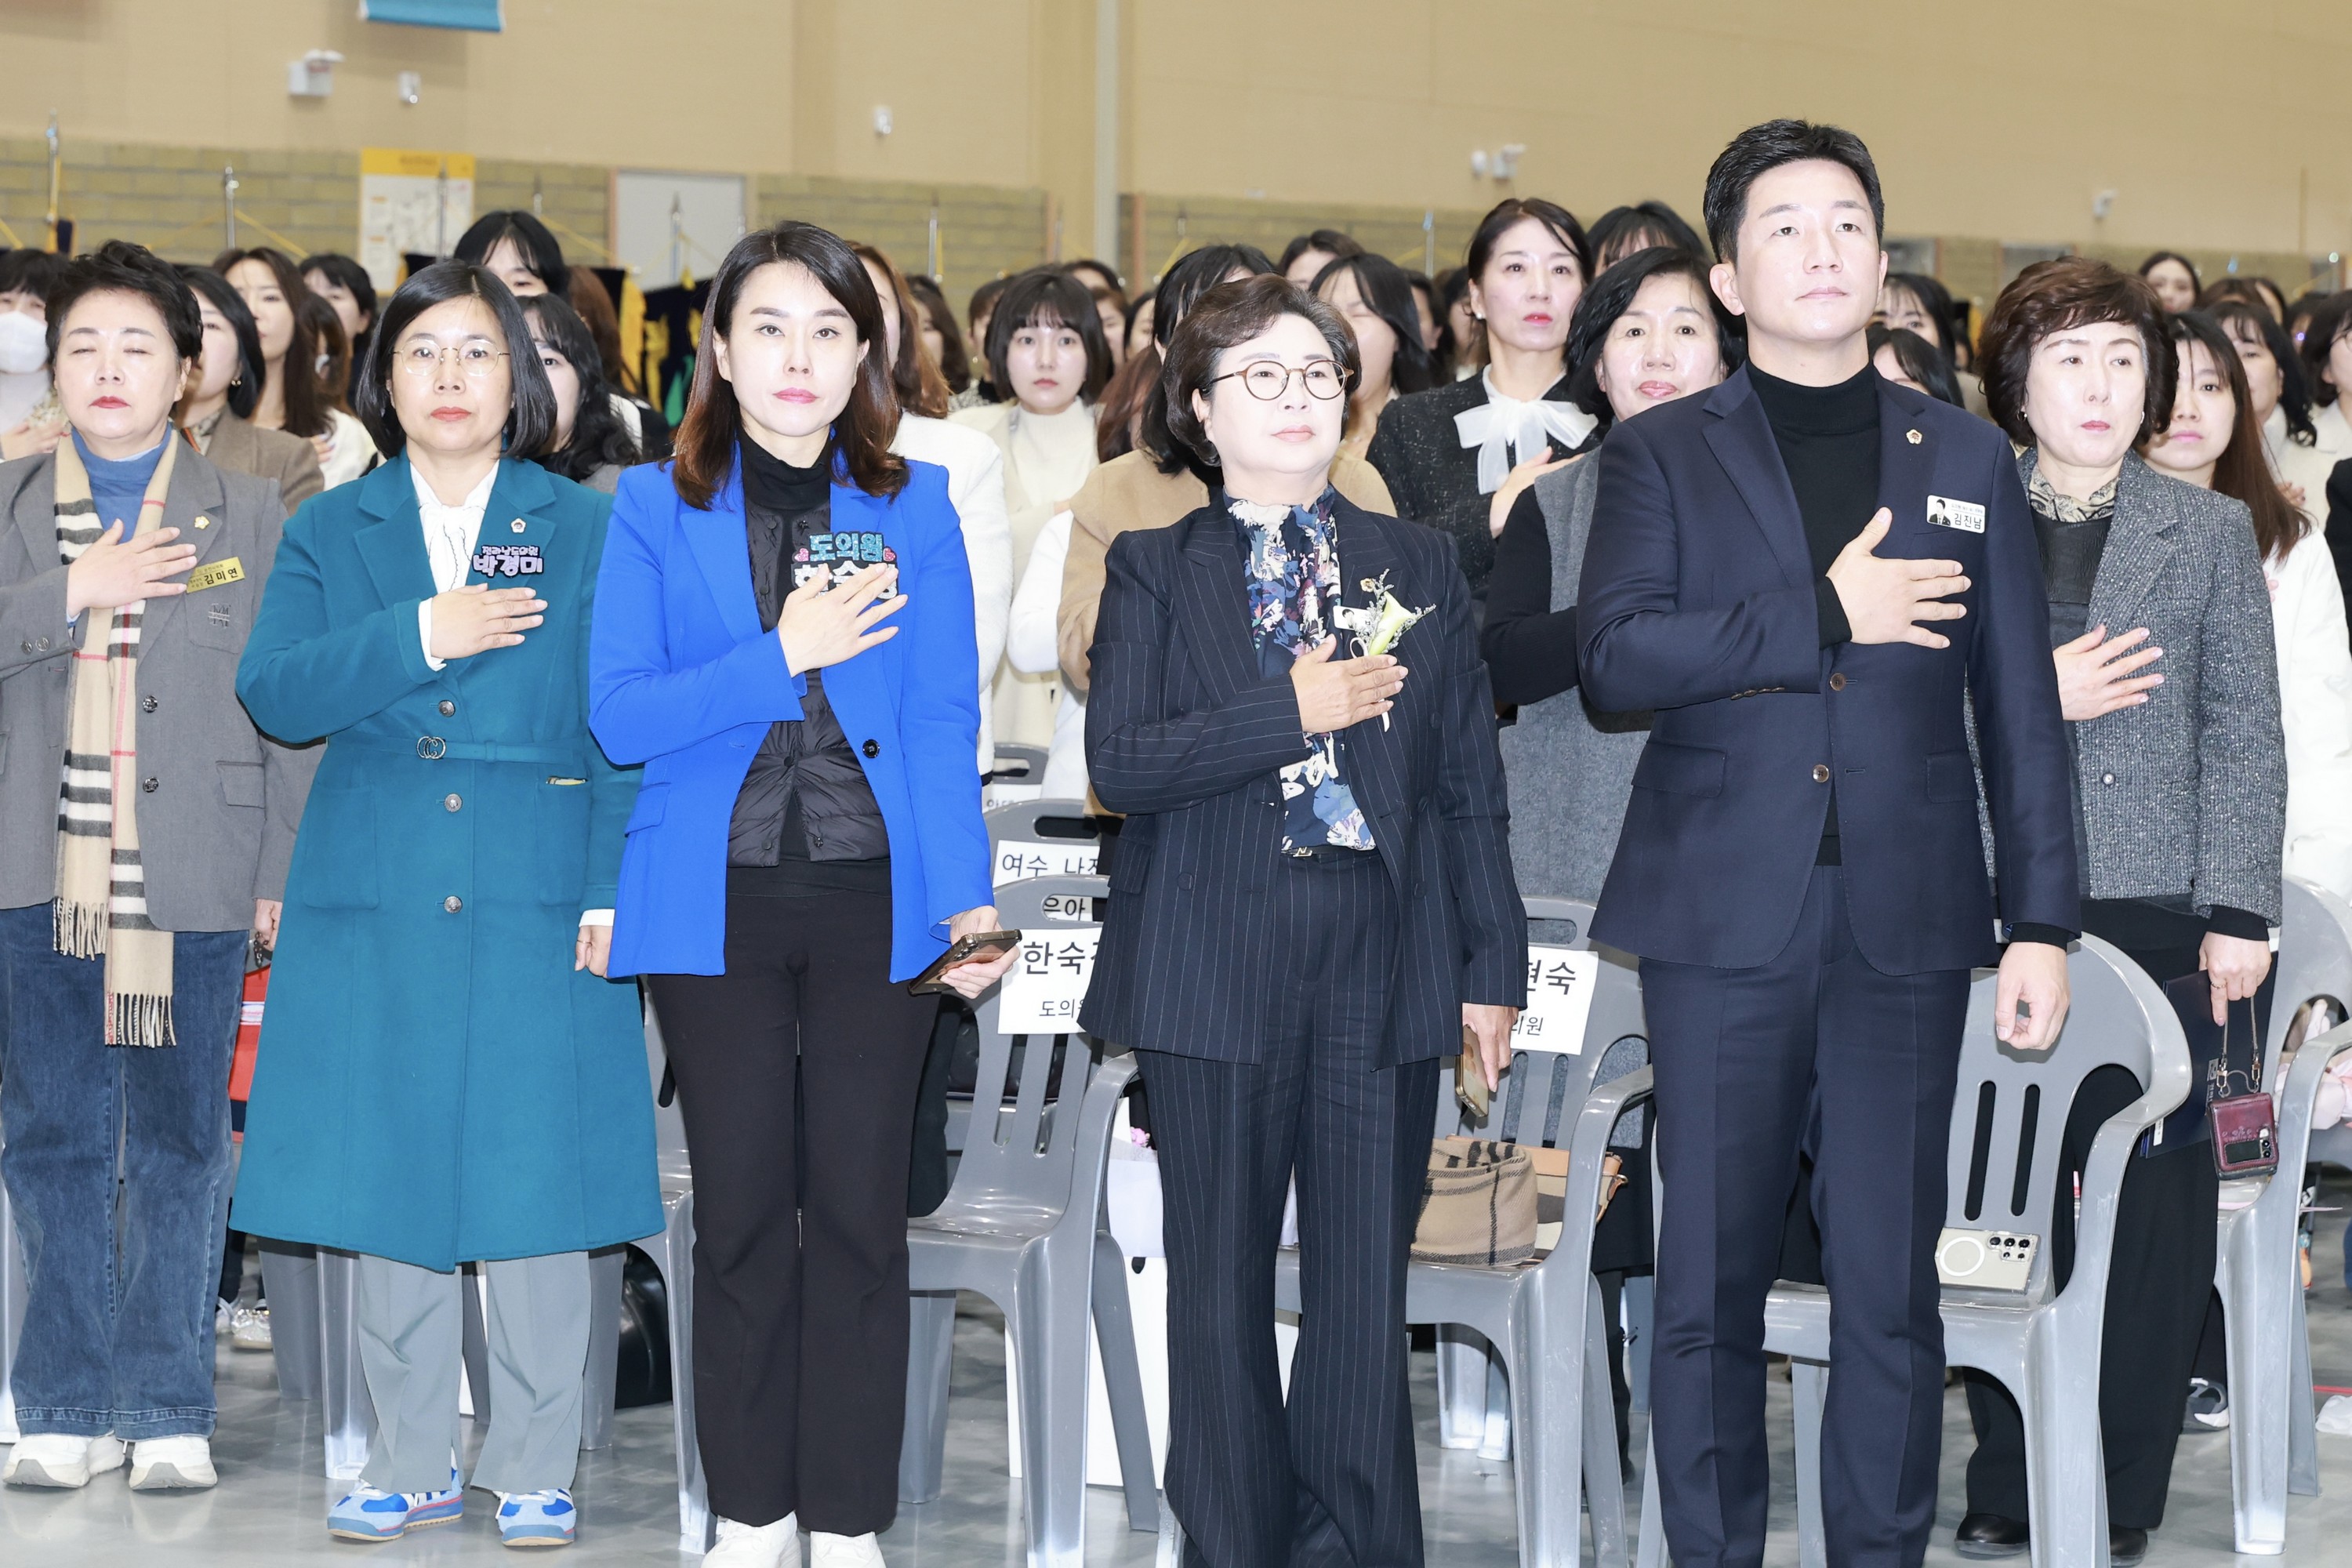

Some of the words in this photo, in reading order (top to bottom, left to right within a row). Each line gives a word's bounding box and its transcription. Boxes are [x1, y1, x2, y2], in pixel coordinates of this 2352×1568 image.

[1954, 513, 1982, 530] 김진남
[809, 532, 883, 562] 도의원
[204, 568, 238, 585] 김미연
[473, 554, 543, 577] 박경미
[1002, 853, 1048, 877] 여수
[1023, 941, 1099, 975] 한숙
[1039, 998, 1084, 1018] 도의
